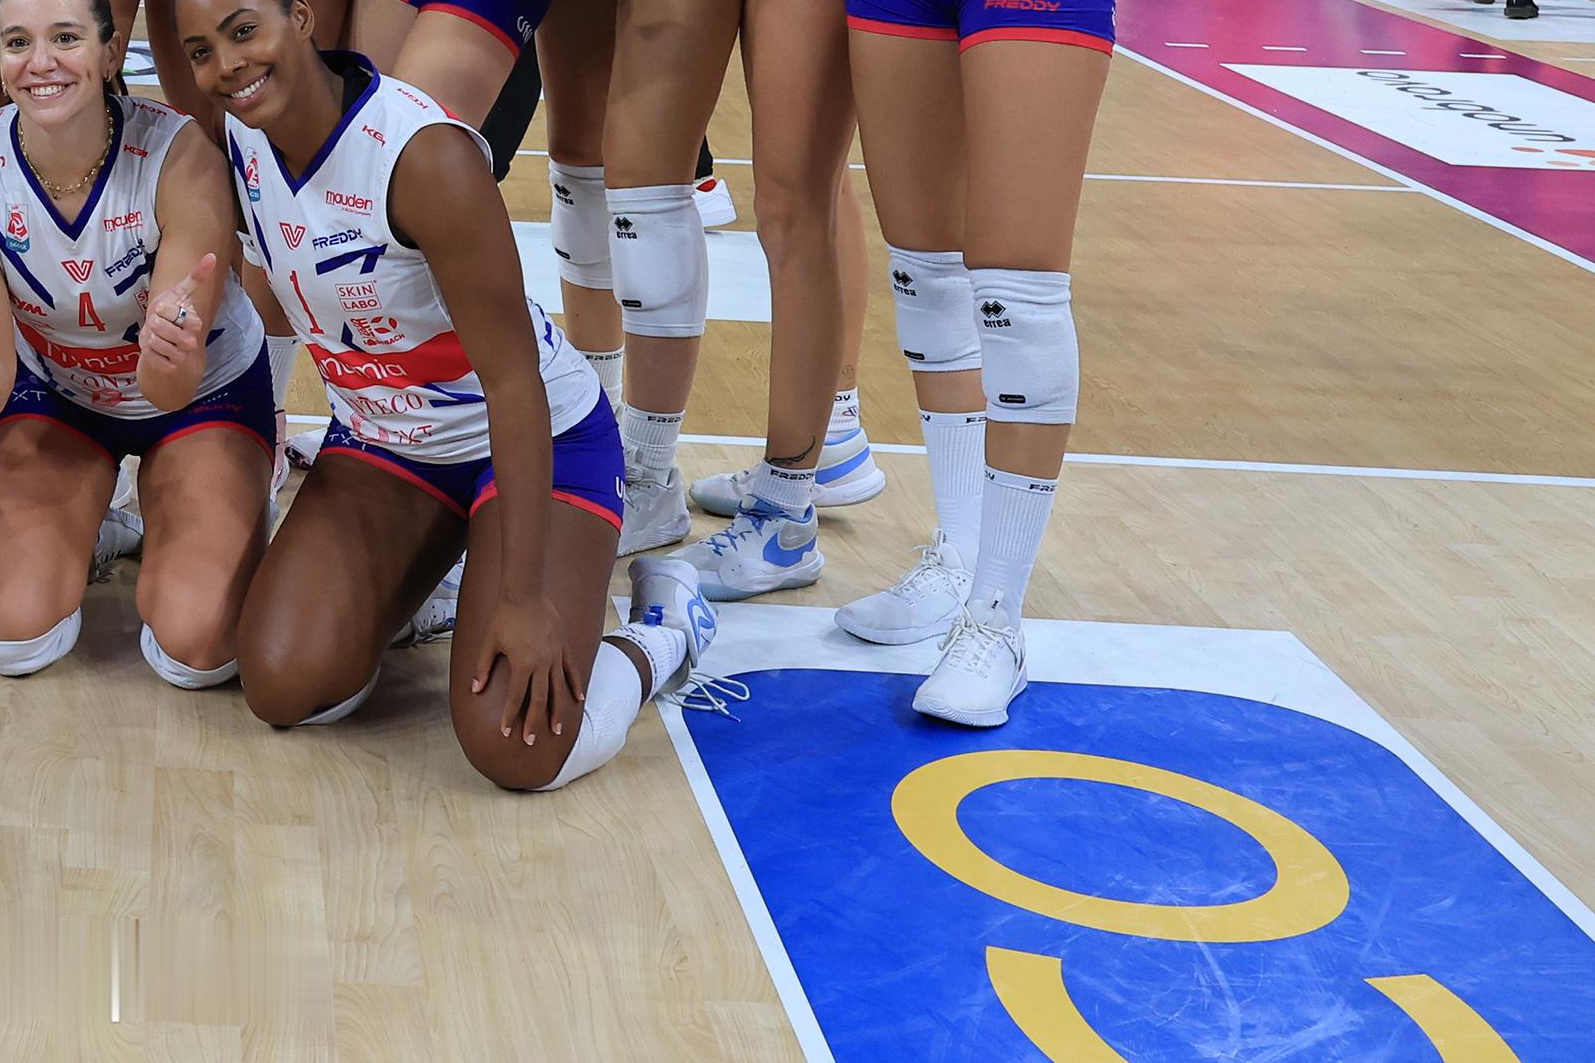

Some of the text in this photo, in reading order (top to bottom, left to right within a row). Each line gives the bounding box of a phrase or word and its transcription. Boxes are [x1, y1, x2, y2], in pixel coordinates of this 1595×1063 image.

[326, 190, 373, 211] mauden
[312, 228, 363, 251] FREDDY
[338, 284, 374, 297] SKIN
[78, 291, 106, 332] 4
[290, 270, 325, 335] 1
[343, 299, 378, 310] LABO
